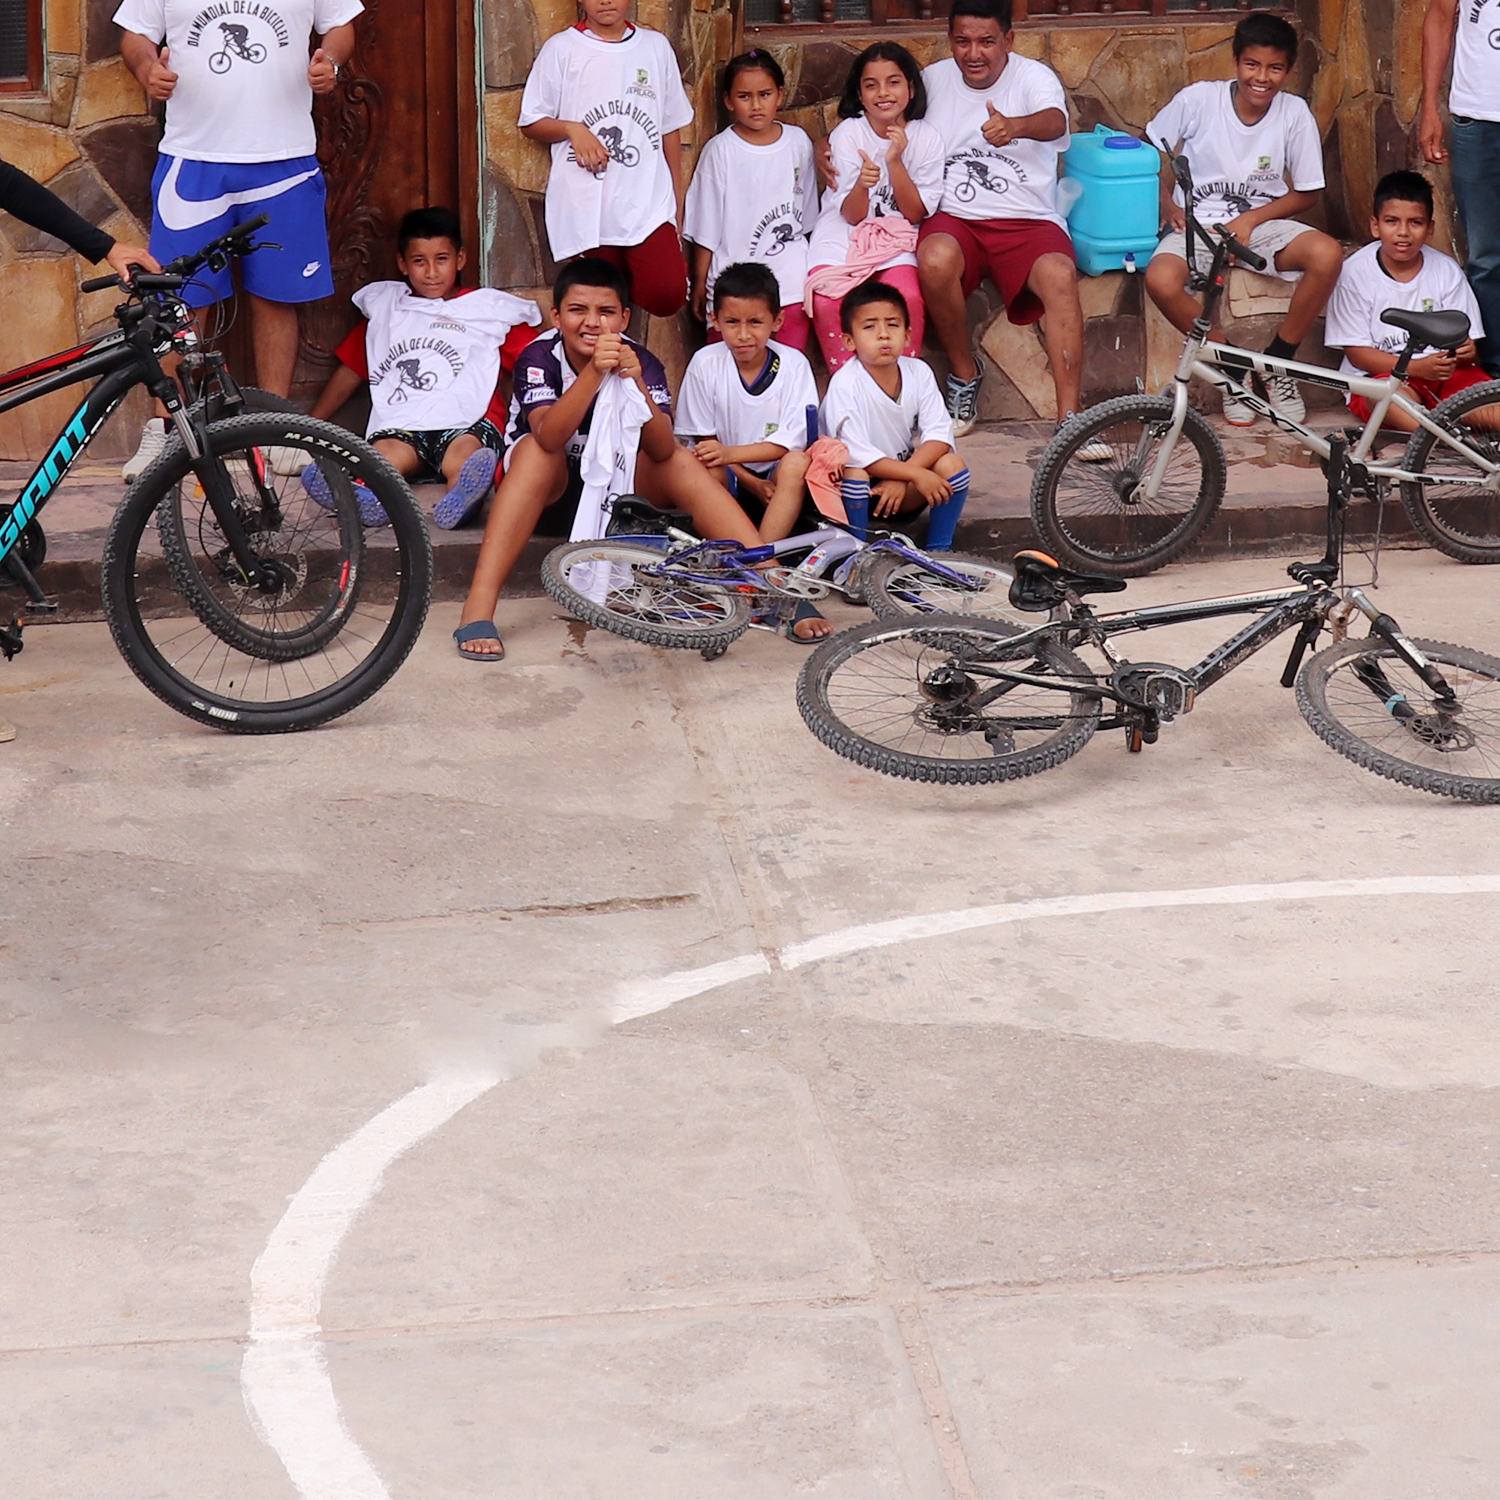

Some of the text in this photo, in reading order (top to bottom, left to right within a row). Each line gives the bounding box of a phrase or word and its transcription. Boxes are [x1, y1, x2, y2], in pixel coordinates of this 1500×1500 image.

[188, 0, 290, 48] DIA MUNDIAL DE LA BICICLETA
[1470, 8, 1479, 24] DIA
[625, 86, 657, 100] JEPELACIO
[607, 100, 660, 151] DE LA BICICLETA
[1239, 182, 1250, 197] DE
[429, 322, 467, 333] JEPELACIO
[409, 338, 422, 351] DE
[421, 337, 436, 350] LA
[1213, 381, 1310, 437] NEXT
[283, 431, 362, 465] MAXXIS
